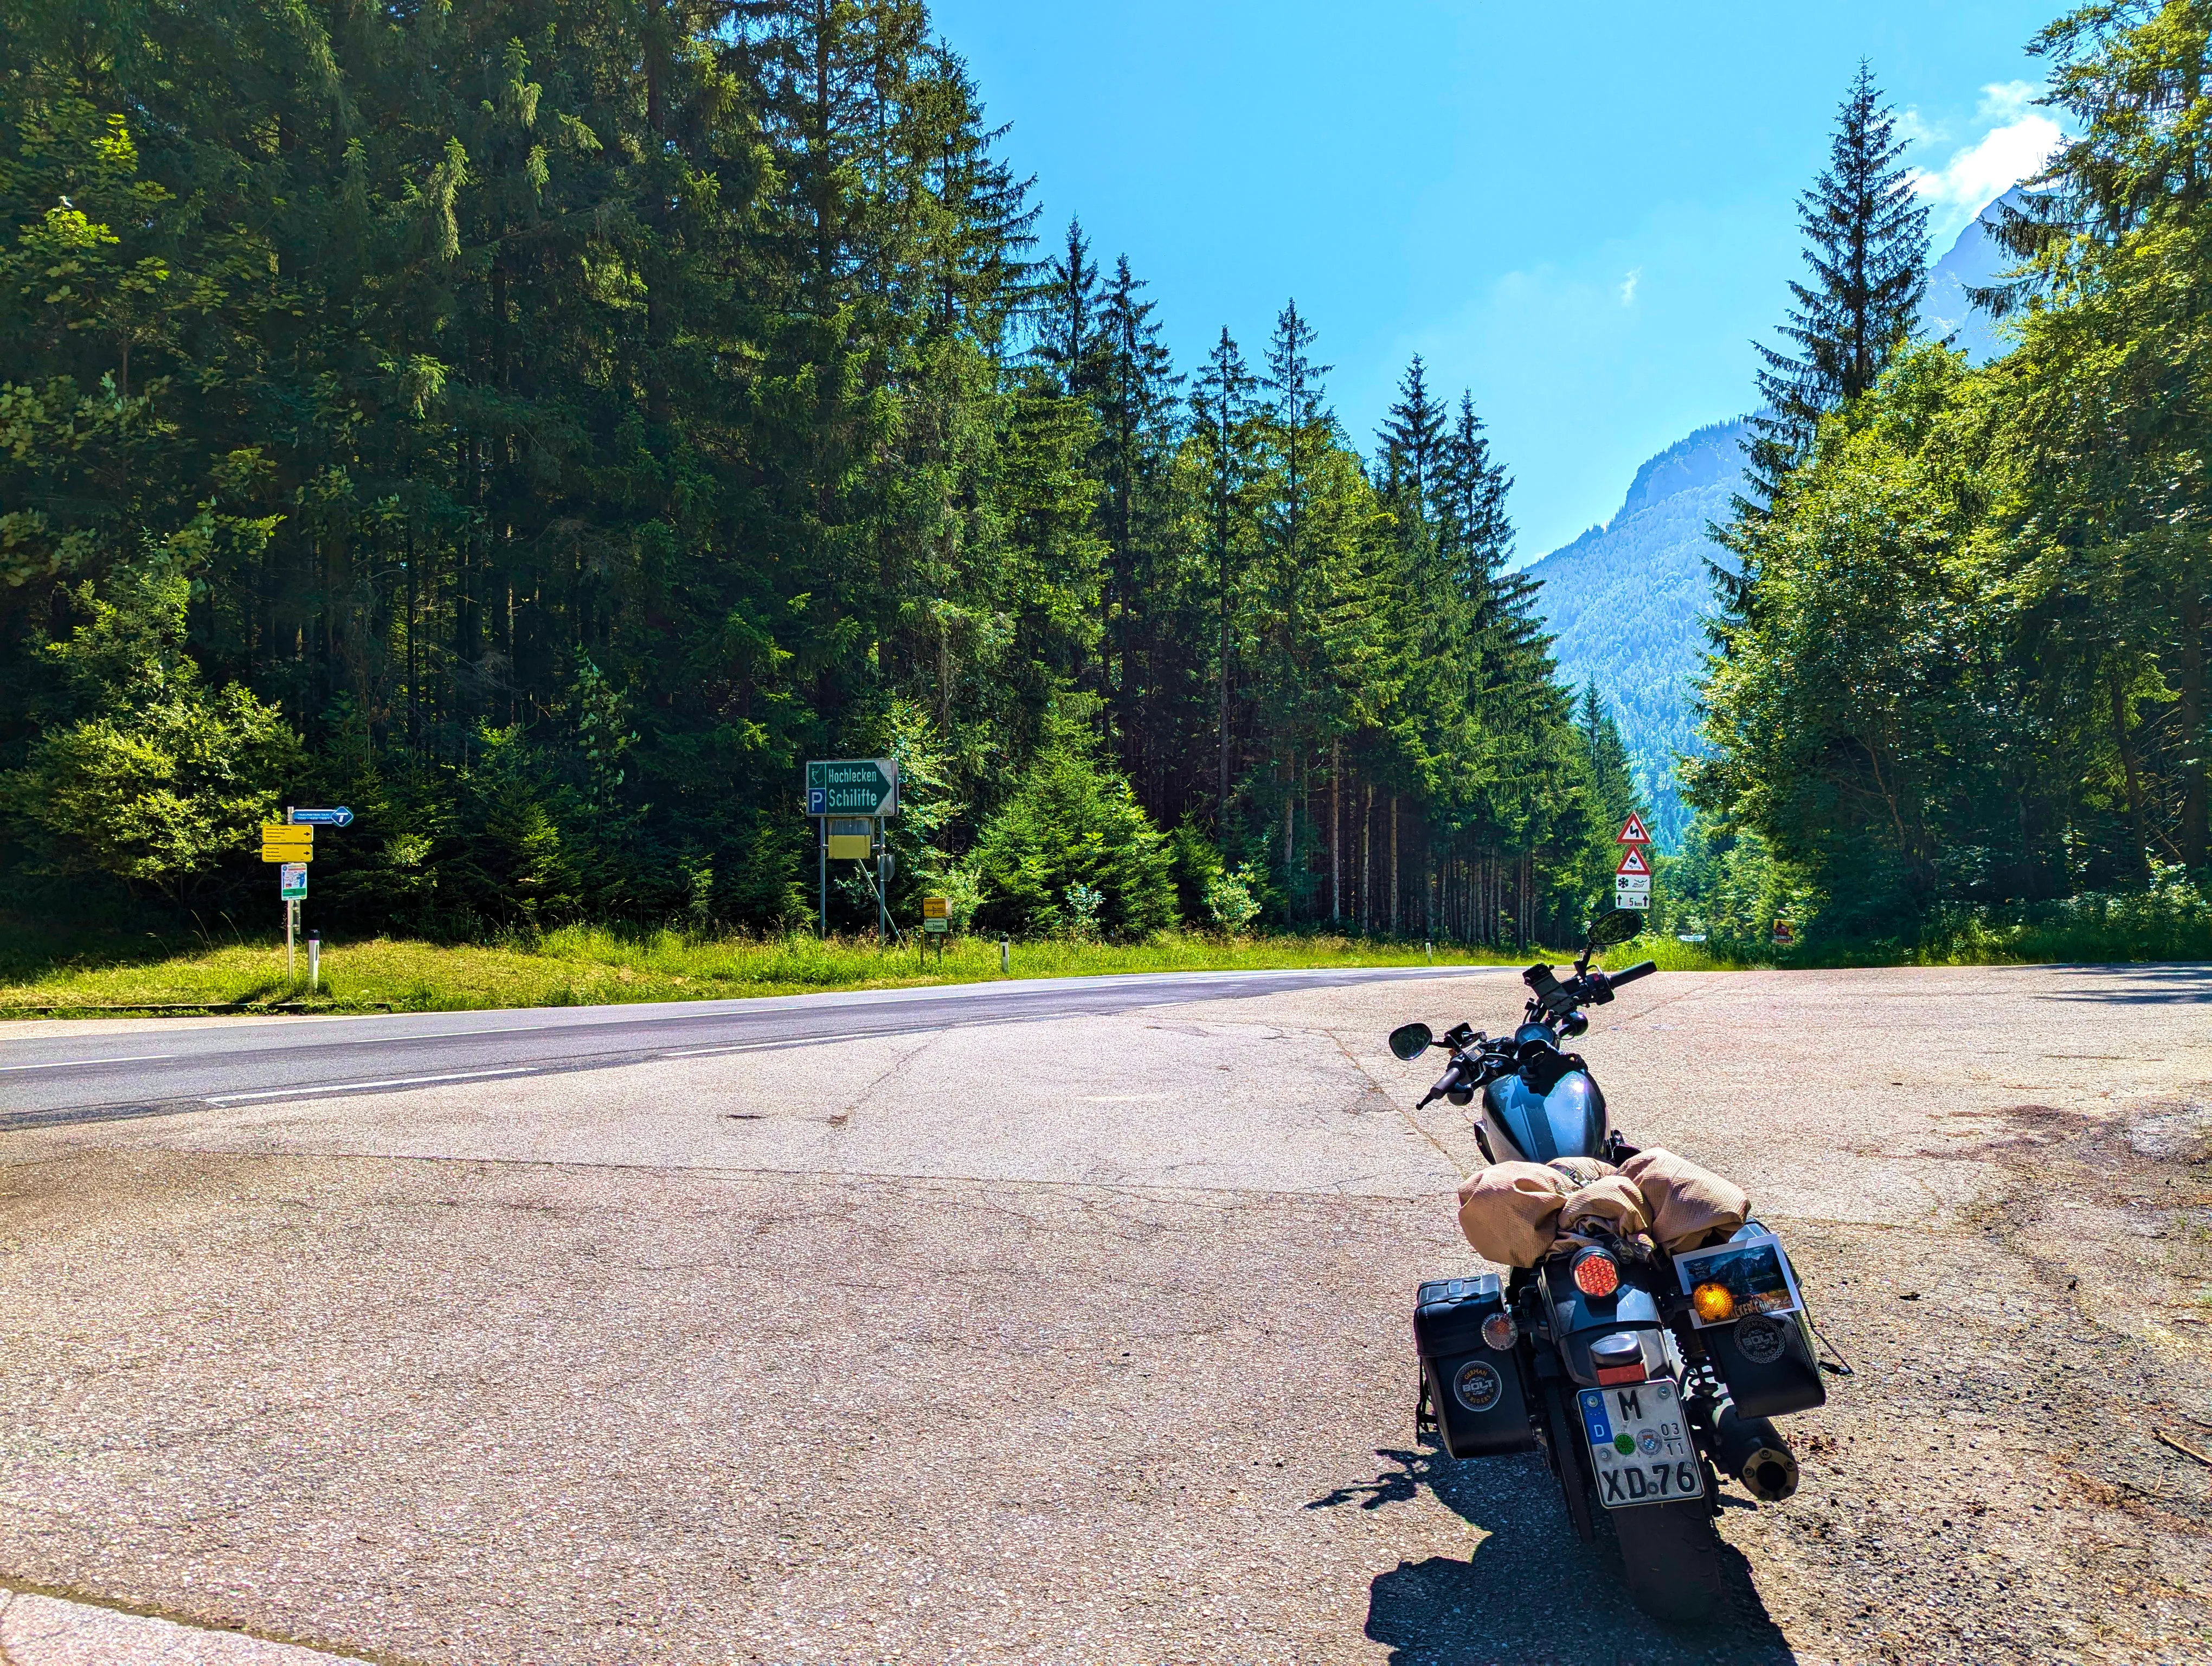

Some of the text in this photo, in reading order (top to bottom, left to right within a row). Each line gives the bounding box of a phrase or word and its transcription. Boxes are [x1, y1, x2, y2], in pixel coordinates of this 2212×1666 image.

[828, 768, 877, 783] Hochlecken
[812, 792, 823, 811] P
[828, 789, 877, 806] Schilifte
[1629, 898, 1634, 906] 5
[1741, 1322, 1769, 1334] GERMAN
[1742, 1332, 1774, 1346] BOLT
[1464, 1368, 1488, 1380] GERMAN
[1462, 1379, 1494, 1392] BOLT
[1469, 1394, 1491, 1404] RIDERS
[1617, 1389, 1643, 1421] M
[1593, 1424, 1605, 1437] D
[1661, 1422, 1680, 1436] 03
[1667, 1443, 1684, 1457] 11
